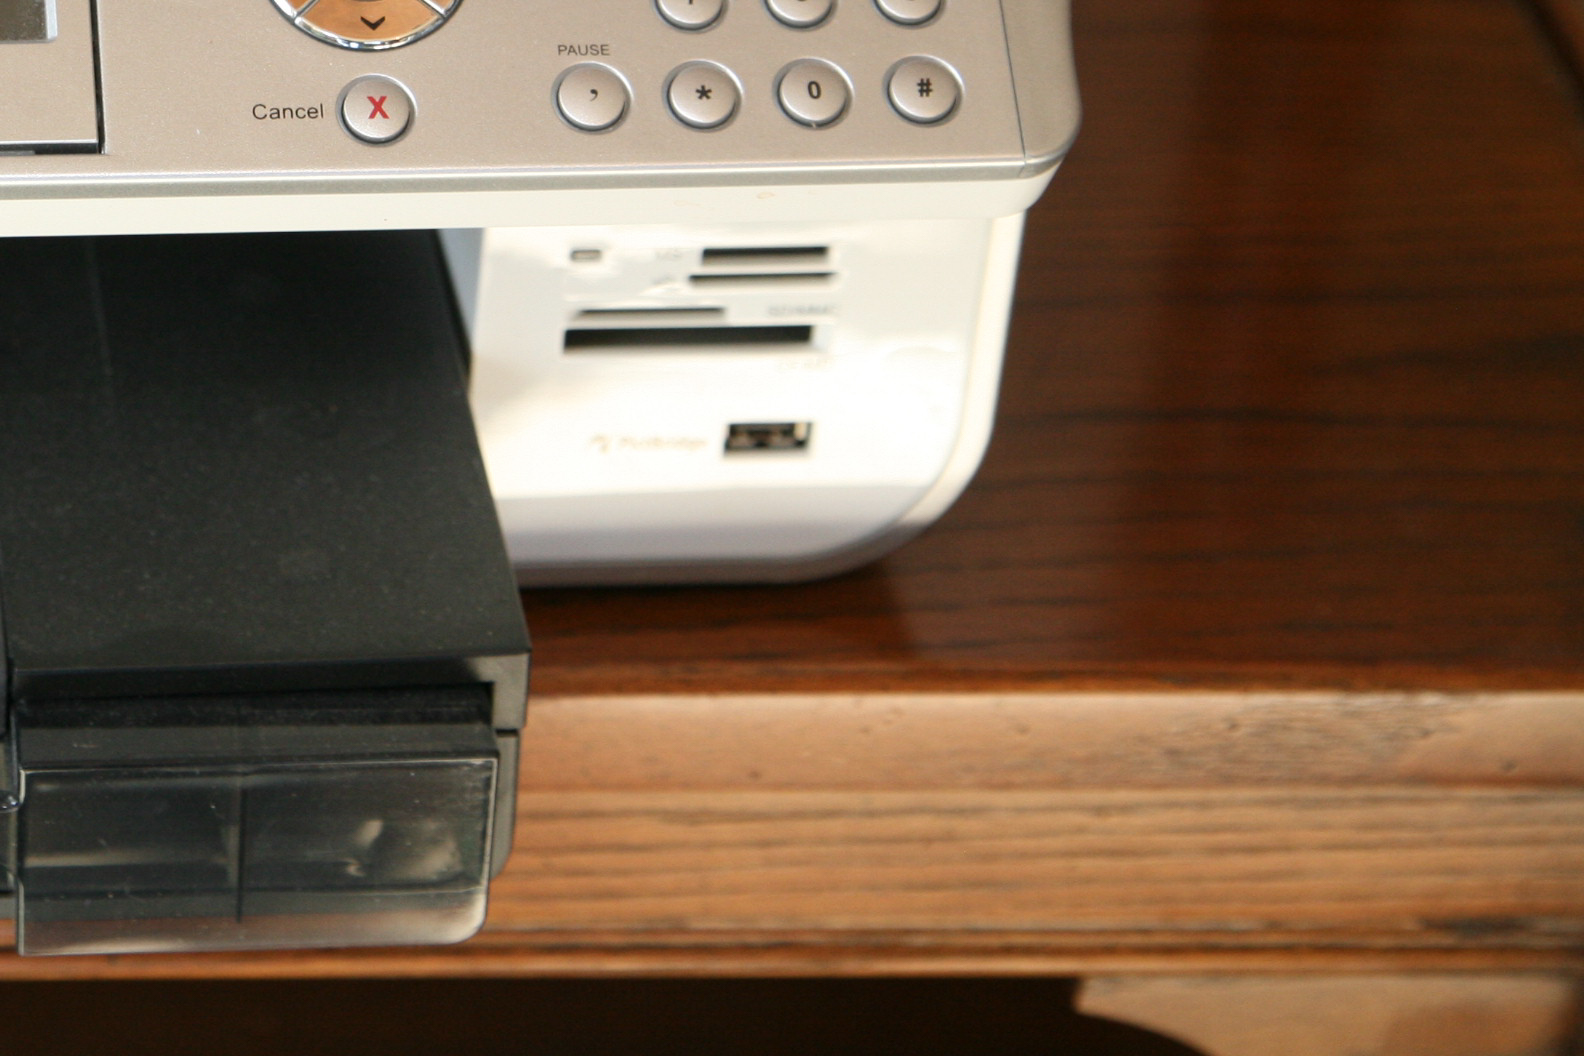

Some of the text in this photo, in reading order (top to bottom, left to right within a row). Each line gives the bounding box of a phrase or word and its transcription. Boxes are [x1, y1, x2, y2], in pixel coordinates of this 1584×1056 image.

[557, 43, 611, 57] PAUSE
[807, 80, 822, 100] 0
[916, 77, 934, 98] #
[252, 102, 324, 121] Cancel
